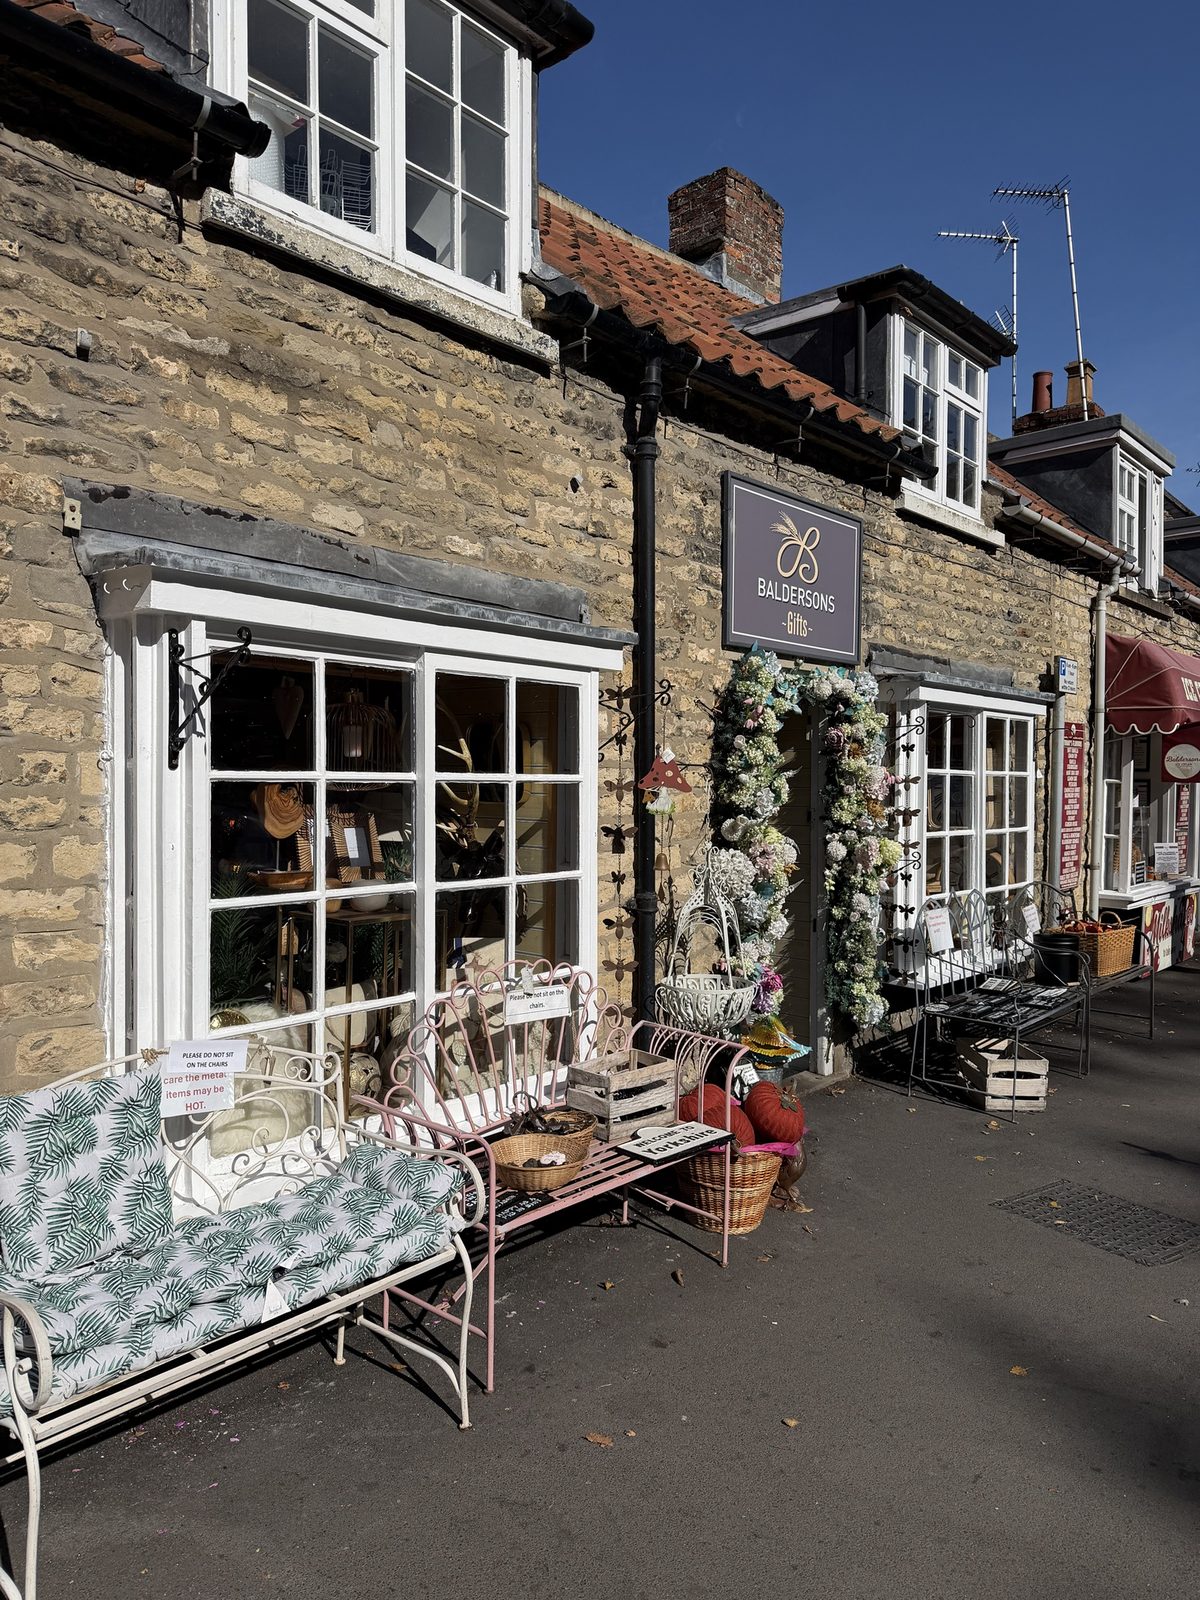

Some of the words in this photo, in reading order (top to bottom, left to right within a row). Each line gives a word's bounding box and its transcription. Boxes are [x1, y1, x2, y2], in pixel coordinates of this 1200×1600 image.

[758, 577, 835, 613] BALDERSONS
[1181, 677, 1198, 702] ICE
[529, 1002, 545, 1010] chairs.
[163, 1076, 183, 1085] care
[185, 1073, 200, 1082] the
[166, 1089, 191, 1099] items
[193, 1088, 212, 1097] may
[213, 1085, 225, 1093] be
[185, 1101, 207, 1111] HOT.
[633, 1130, 681, 1148] WELCOME
[681, 1125, 695, 1133] TO
[642, 1129, 718, 1155] Yorkshire
